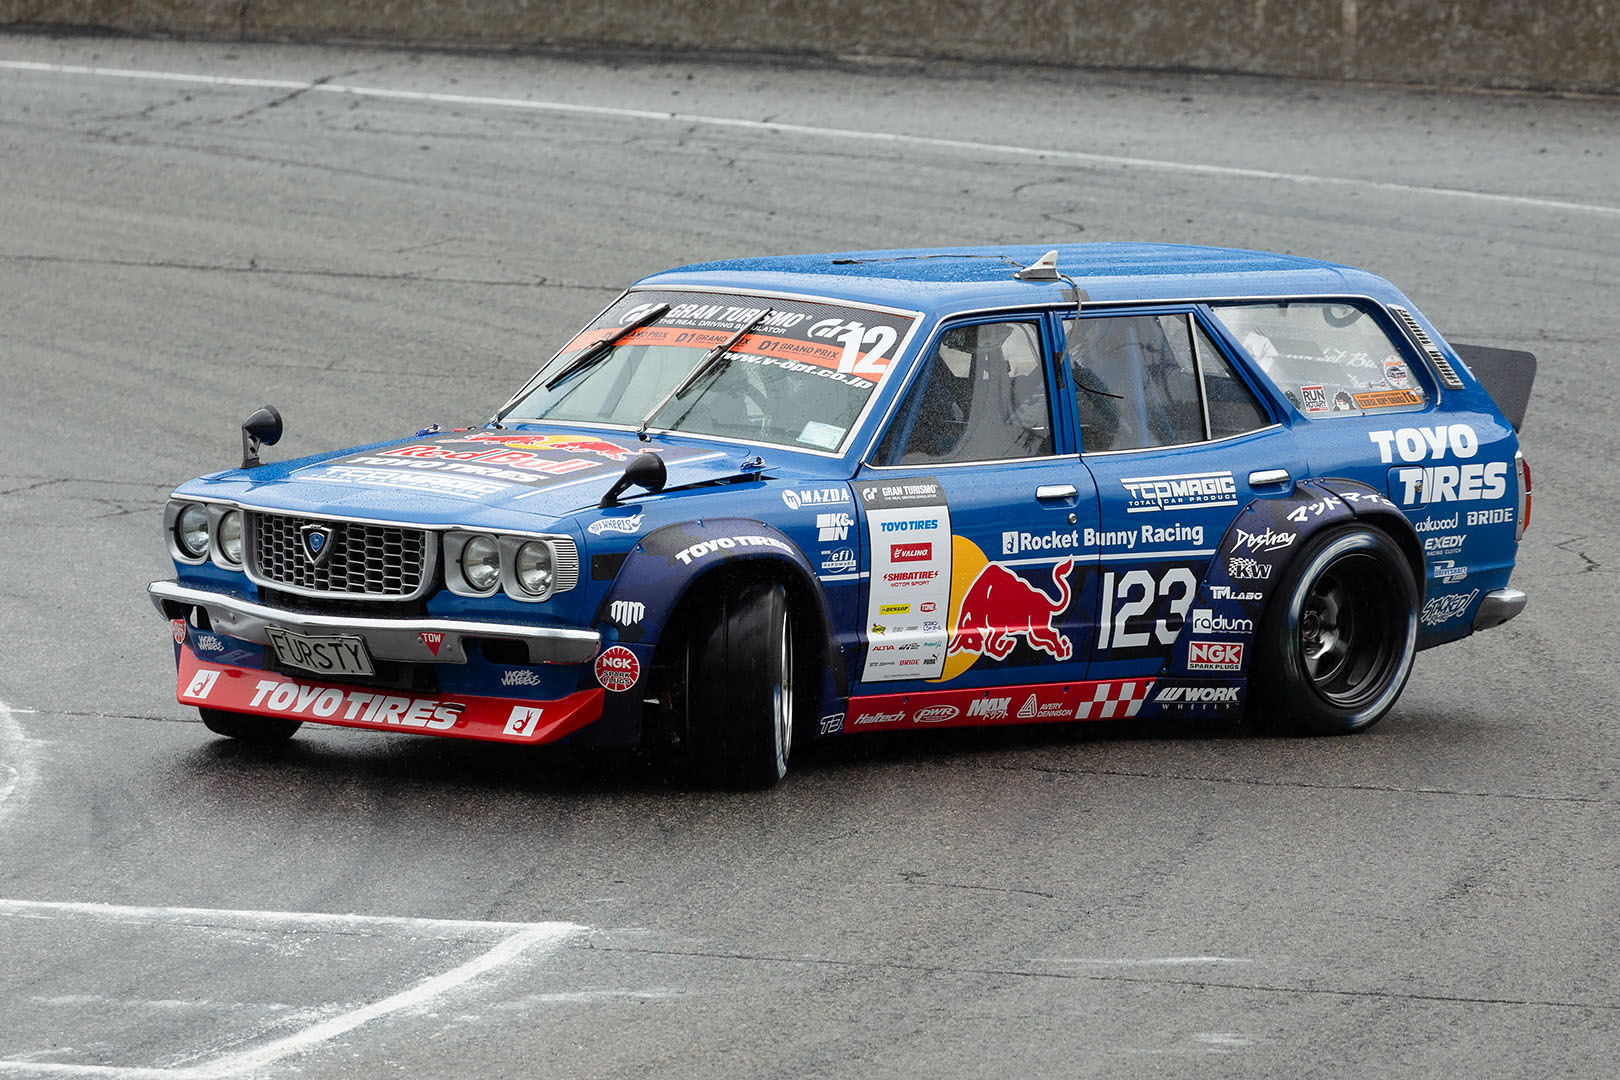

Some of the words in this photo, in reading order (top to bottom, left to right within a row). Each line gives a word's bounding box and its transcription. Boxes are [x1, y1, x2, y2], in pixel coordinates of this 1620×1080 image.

[665, 303, 724, 321] GRAN
[697, 320, 734, 329] DRIVING
[734, 323, 787, 335] SIULATOR
[675, 332, 697, 343] D1
[695, 334, 728, 343] GRAND
[757, 340, 780, 351] D1
[779, 343, 814, 354] GRAND
[814, 348, 839, 359] PRIX
[837, 325, 897, 374] 12
[1302, 388, 1325, 401] RUN
[1368, 423, 1479, 464] TOYO
[345, 456, 437, 469] TOYO
[375, 444, 498, 464] Red
[470, 448, 603, 475] Bull
[881, 485, 902, 497] GRAN
[1399, 462, 1508, 506] TIRES
[800, 488, 850, 503] MAZDA
[1128, 499, 1156, 507] TOTAL
[1164, 497, 1184, 505] CAR
[1189, 493, 1237, 503] PRODUCE
[1466, 507, 1514, 526] BRIDE
[880, 521, 908, 532] TOYO
[908, 519, 938, 530] TIRES
[1020, 529, 1079, 551] Rocket
[1083, 527, 1138, 549] Bunny
[1141, 523, 1204, 546] Racing
[1424, 534, 1468, 551] EXEDY
[674, 537, 736, 566] TOYO
[901, 548, 929, 558] VALINO
[886, 570, 935, 582] SHIBATIRE
[1234, 562, 1273, 579] KW
[1097, 565, 1198, 649] 123
[421, 632, 441, 643] TOW
[270, 633, 365, 672] FURSTY
[1190, 643, 1241, 663] NGK
[602, 656, 632, 670] NGK
[1189, 662, 1214, 670] SPARK
[1214, 663, 1240, 671] PLUGS
[602, 676, 630, 685] PLUGS
[603, 670, 631, 679] SPARK
[1184, 686, 1241, 701] WORK
[249, 679, 344, 718] TOYO
[343, 690, 465, 731] TIRES
[1040, 702, 1064, 711] AVERY
[853, 709, 907, 725] Haltech
[1036, 708, 1073, 718] DENNISON
